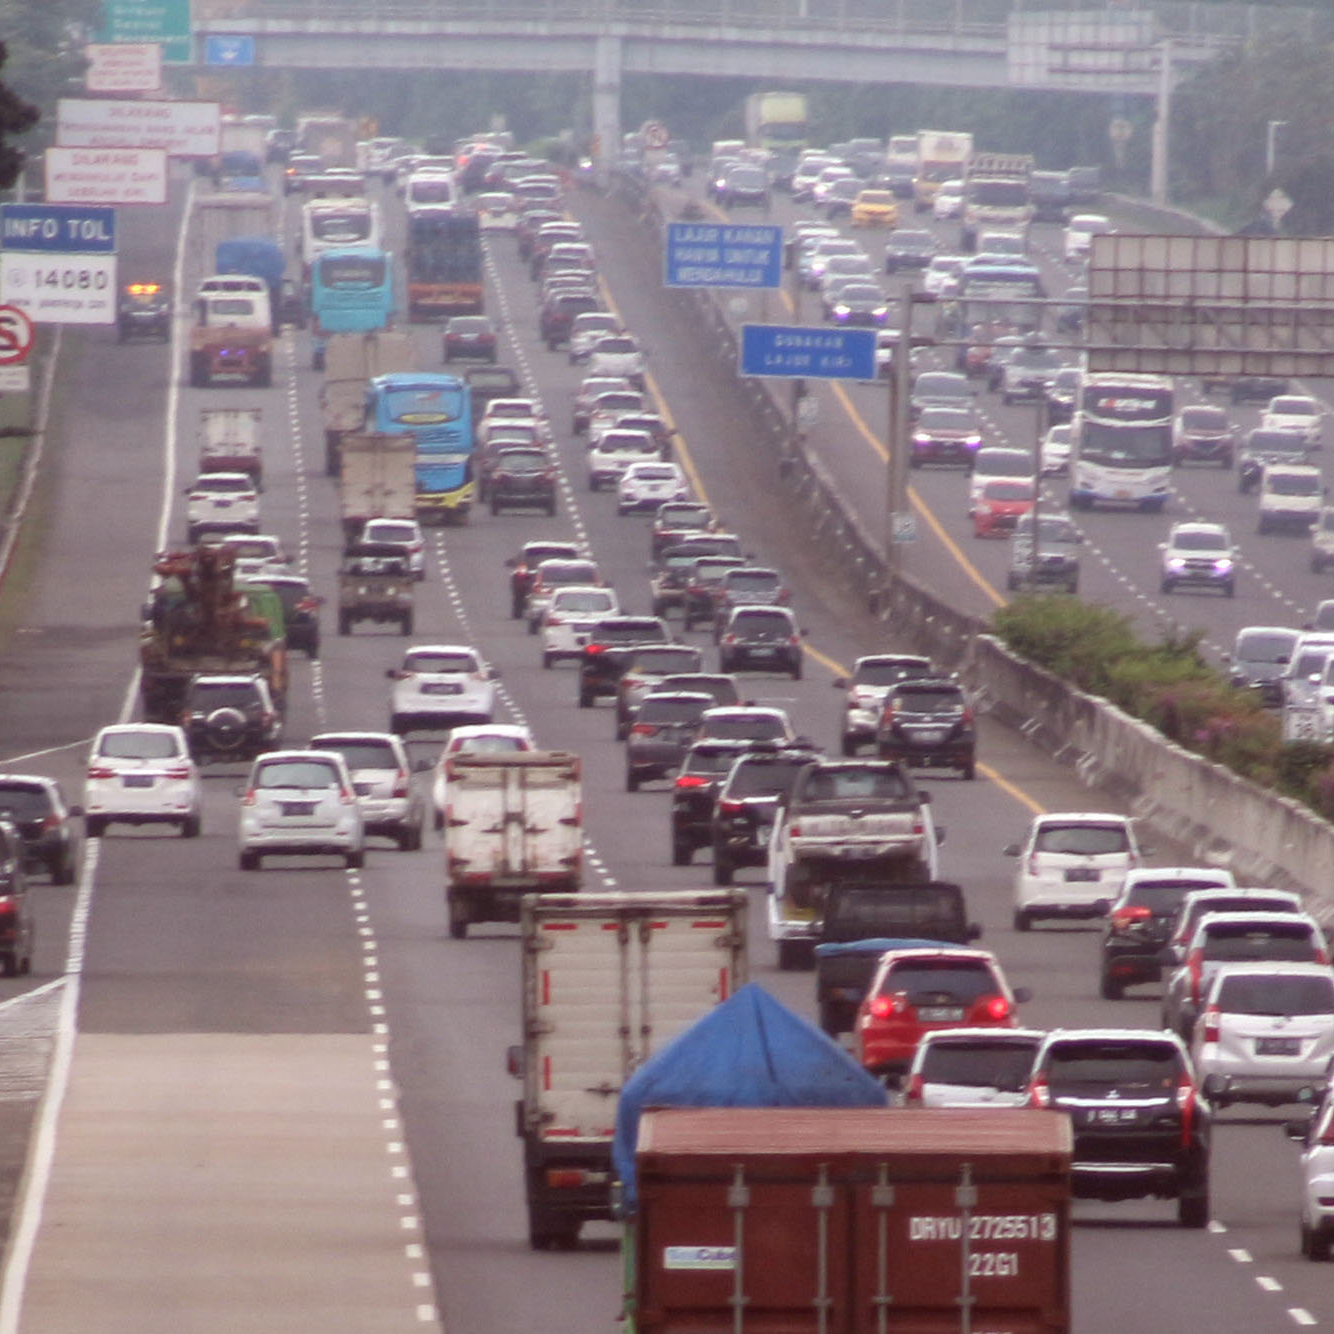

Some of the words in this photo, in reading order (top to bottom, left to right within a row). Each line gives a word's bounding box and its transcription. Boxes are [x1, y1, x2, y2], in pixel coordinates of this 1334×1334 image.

[4, 217, 59, 239] INFO
[68, 219, 112, 241] TOL
[35, 269, 109, 291] 14080
[909, 1216, 963, 1241] DRYU
[969, 1214, 1057, 1241] 2725513
[969, 1252, 1019, 1276] 22G1
